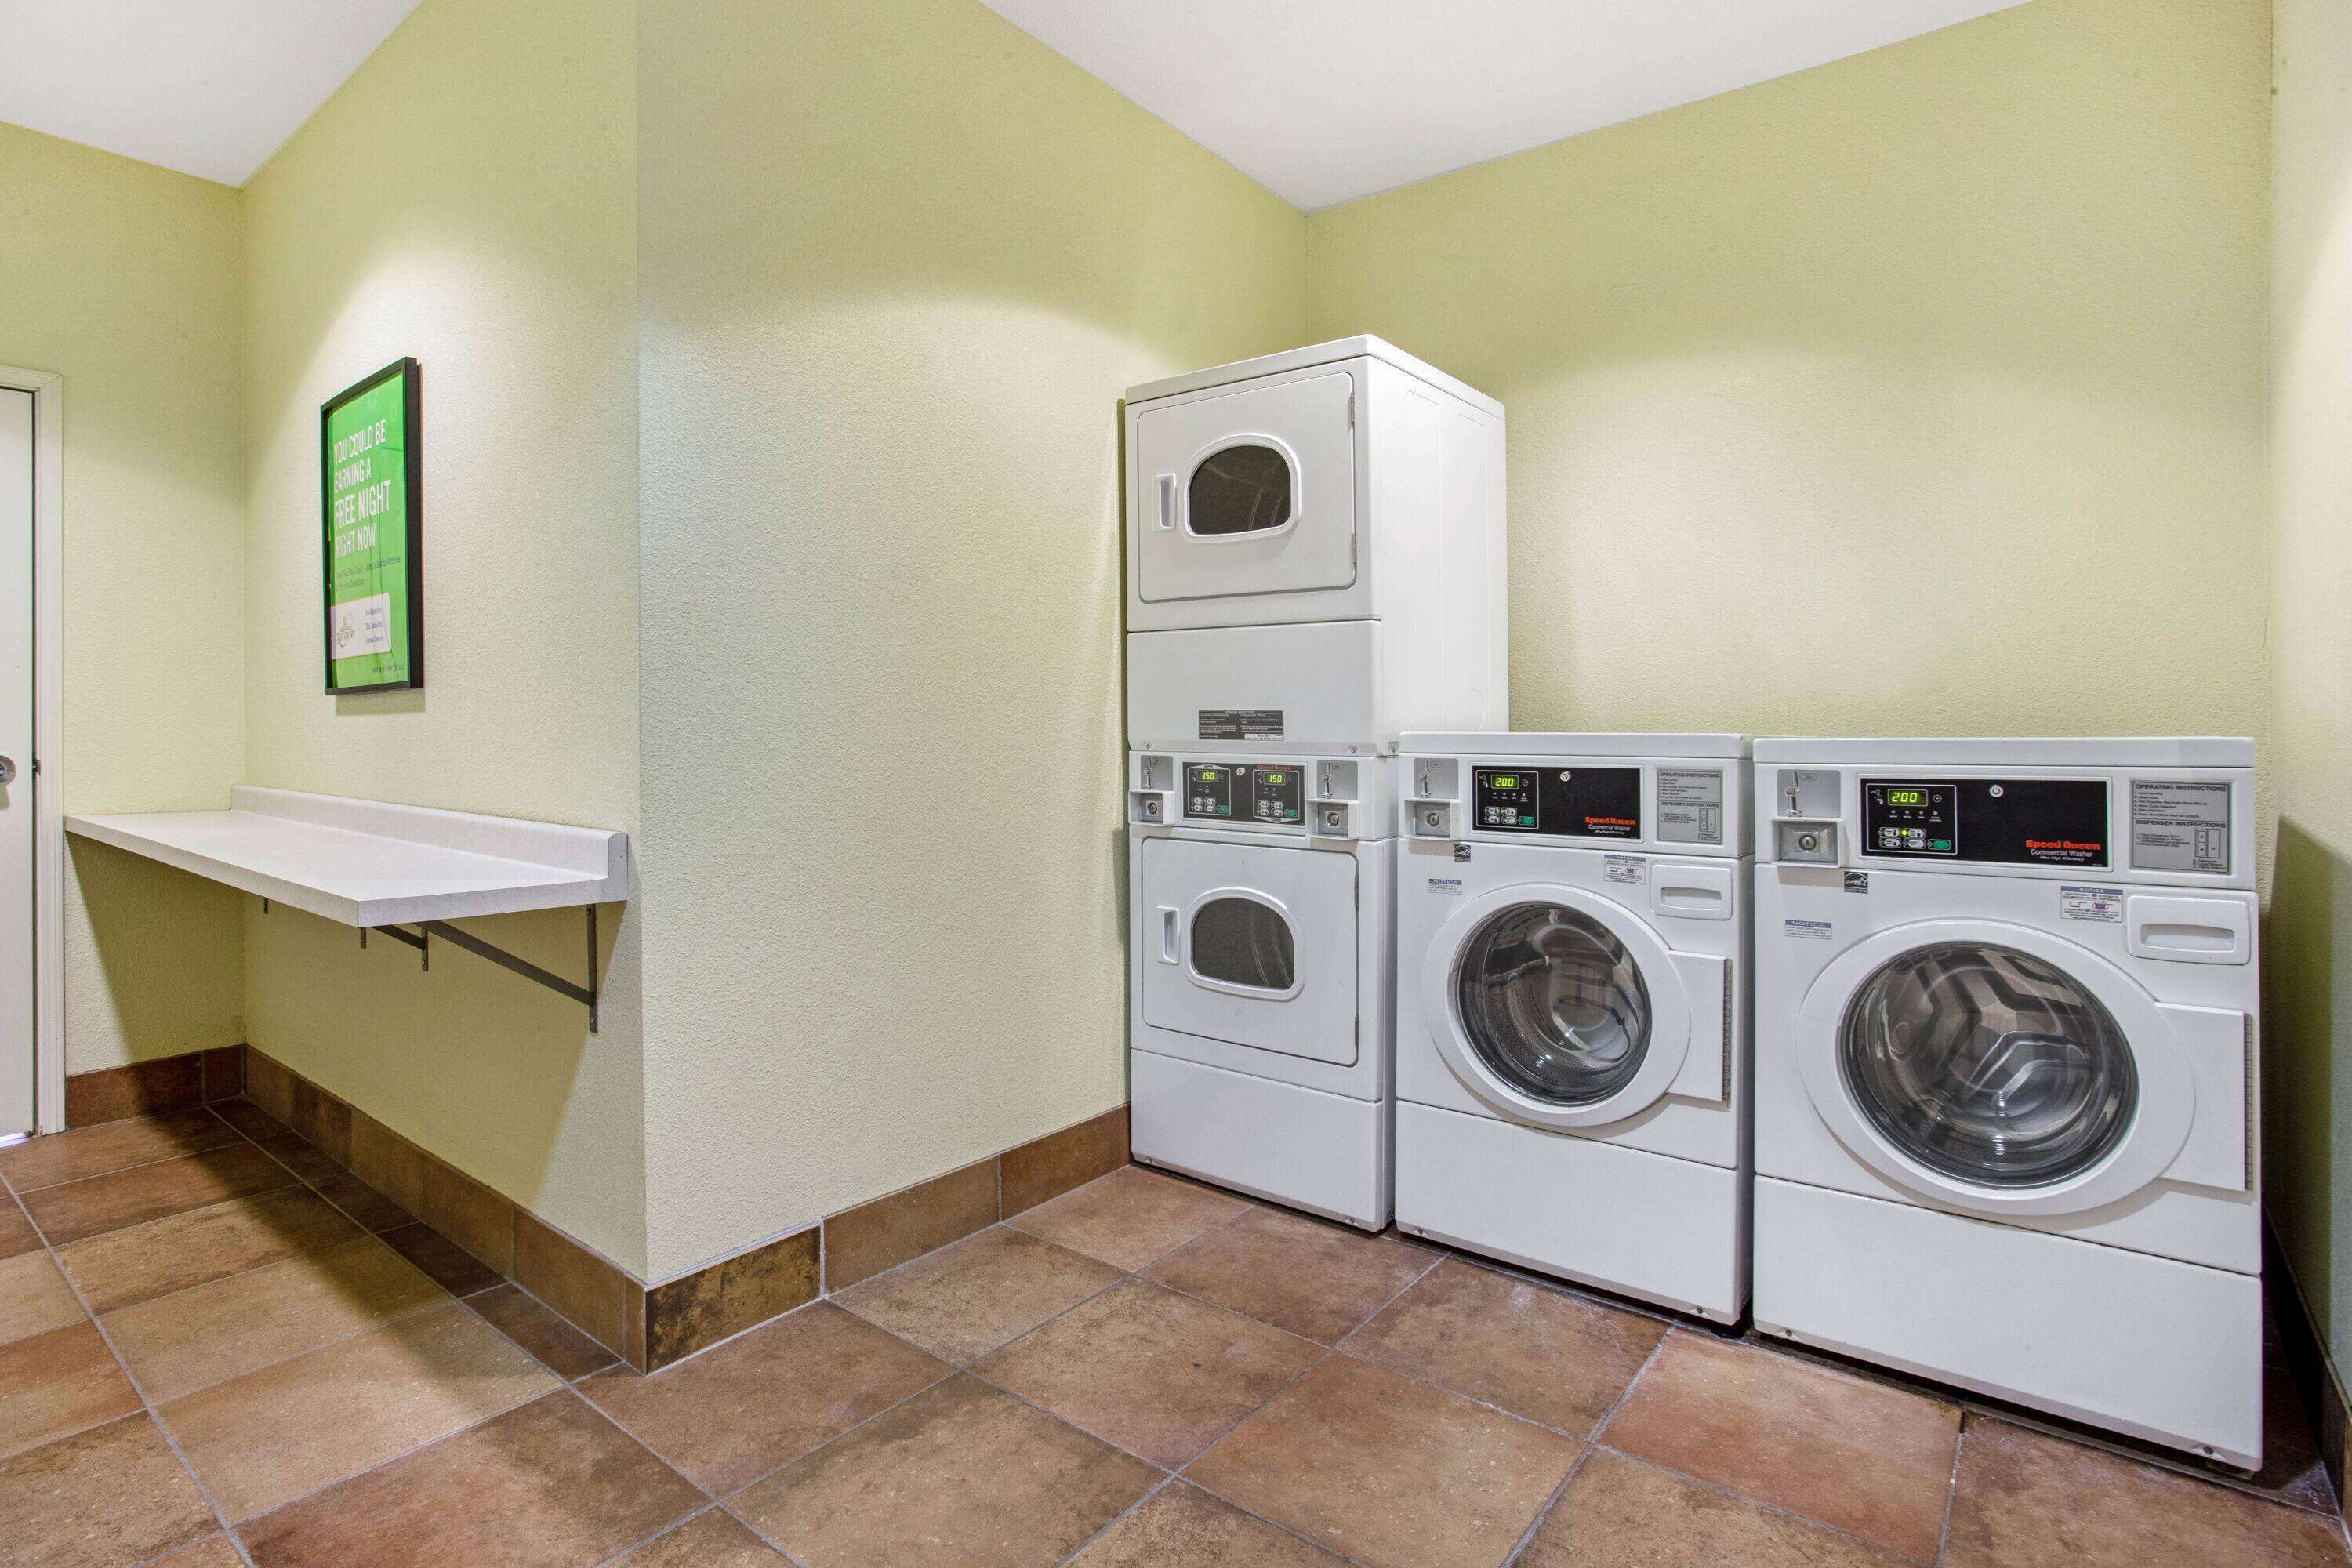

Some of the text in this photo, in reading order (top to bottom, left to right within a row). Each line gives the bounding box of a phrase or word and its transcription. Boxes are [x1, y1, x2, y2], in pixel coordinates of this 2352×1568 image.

[334, 419, 386, 466] YOU COULD BE
[335, 456, 372, 494] EARNING A
[334, 479, 391, 530] FREE NIGHT
[335, 522, 376, 558] RIGHT NOW
[1495, 777, 1514, 787] 200
[1891, 792, 1918, 803] 200
[2025, 840, 2101, 850] Speed Queen
